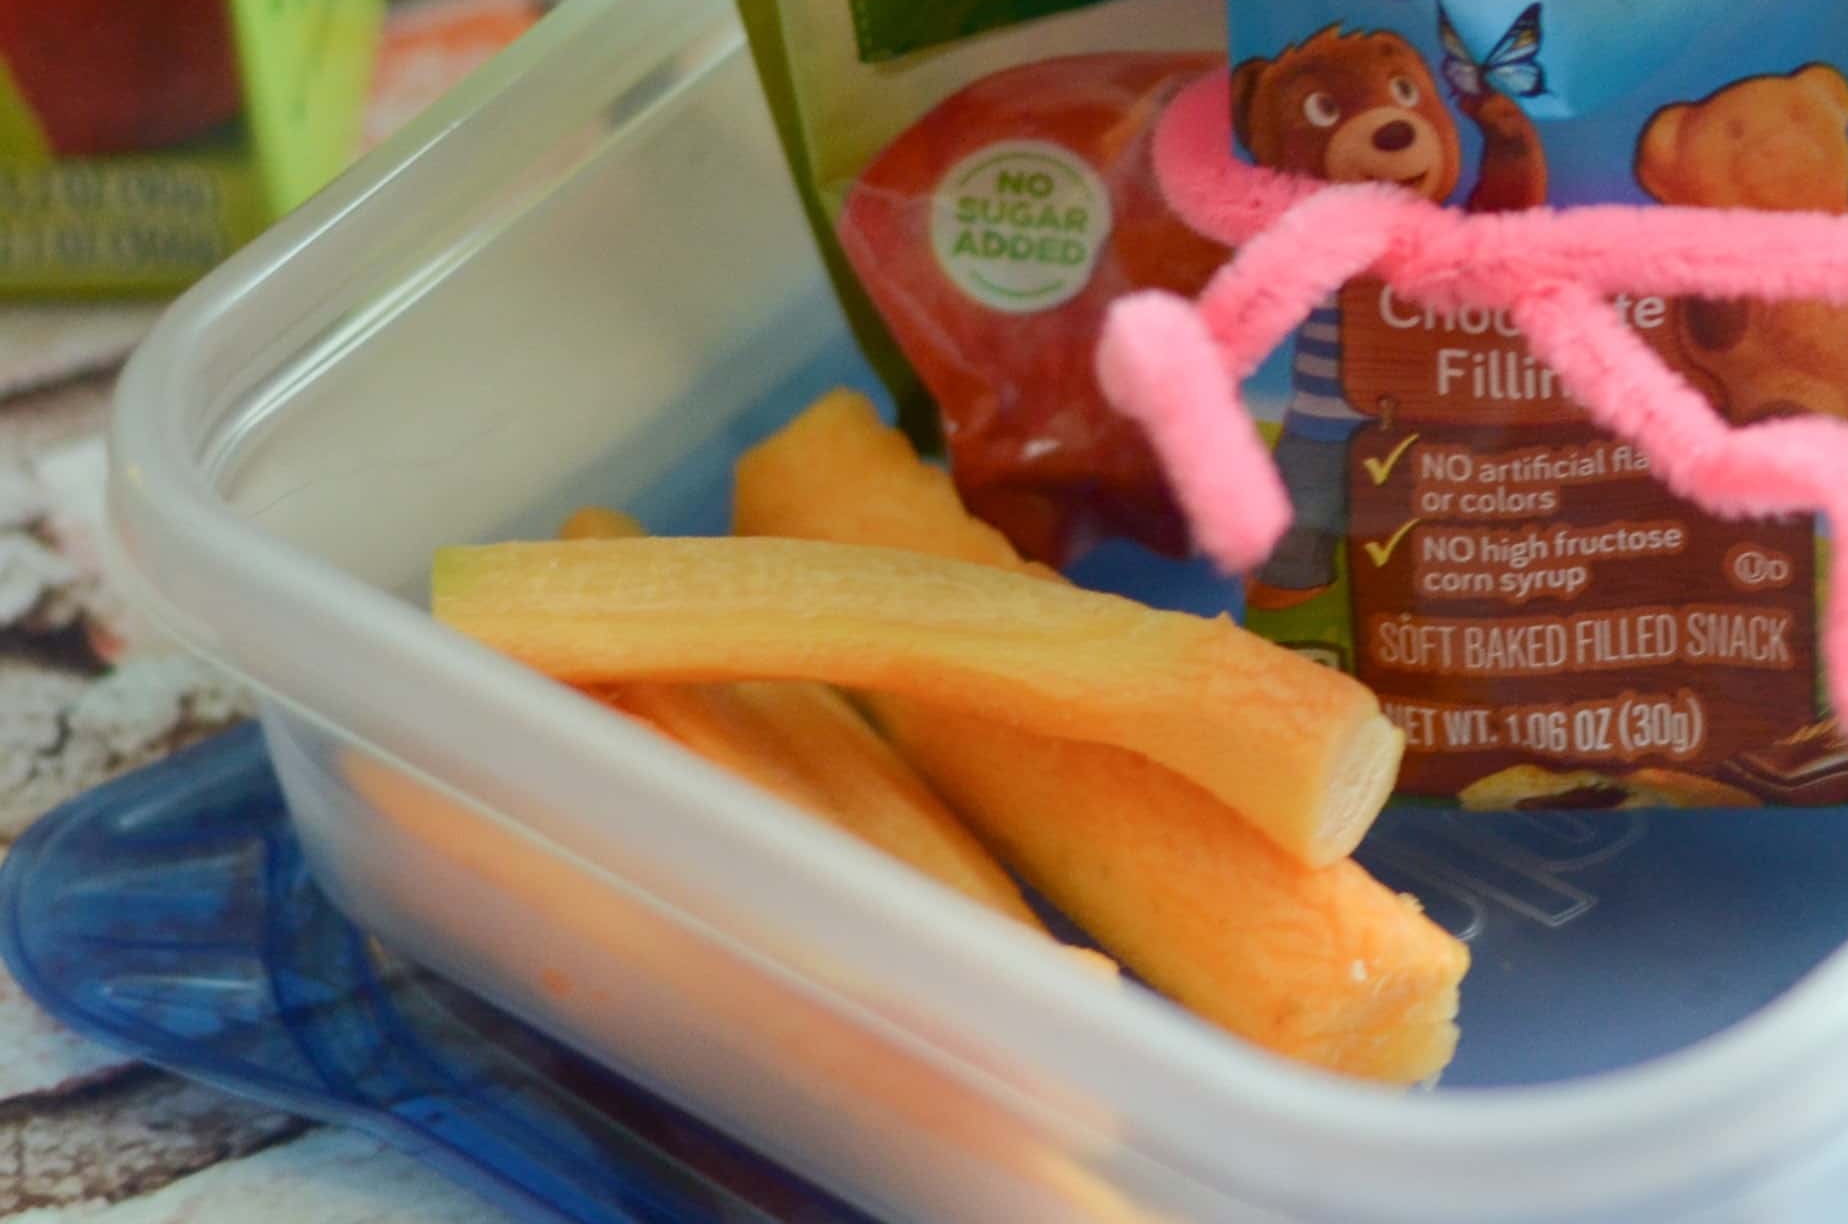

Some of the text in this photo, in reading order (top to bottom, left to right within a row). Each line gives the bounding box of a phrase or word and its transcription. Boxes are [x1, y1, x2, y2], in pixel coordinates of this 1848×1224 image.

[998, 170, 1054, 199] NO
[956, 197, 1089, 234] SUGAR
[952, 229, 1088, 266] ADDED
[1421, 446, 1649, 482] NO artificial fla
[1421, 485, 1556, 513] or colors
[1423, 528, 1681, 569] NO high fructose
[1424, 566, 1587, 598] corn syrup
[1379, 613, 1789, 669] SOFT BAKED FILLED SNACK
[1443, 708, 1498, 747] WT.
[1506, 712, 1568, 752] 1.06
[1575, 707, 1611, 751] OZ
[1618, 698, 1702, 753] (30g)
